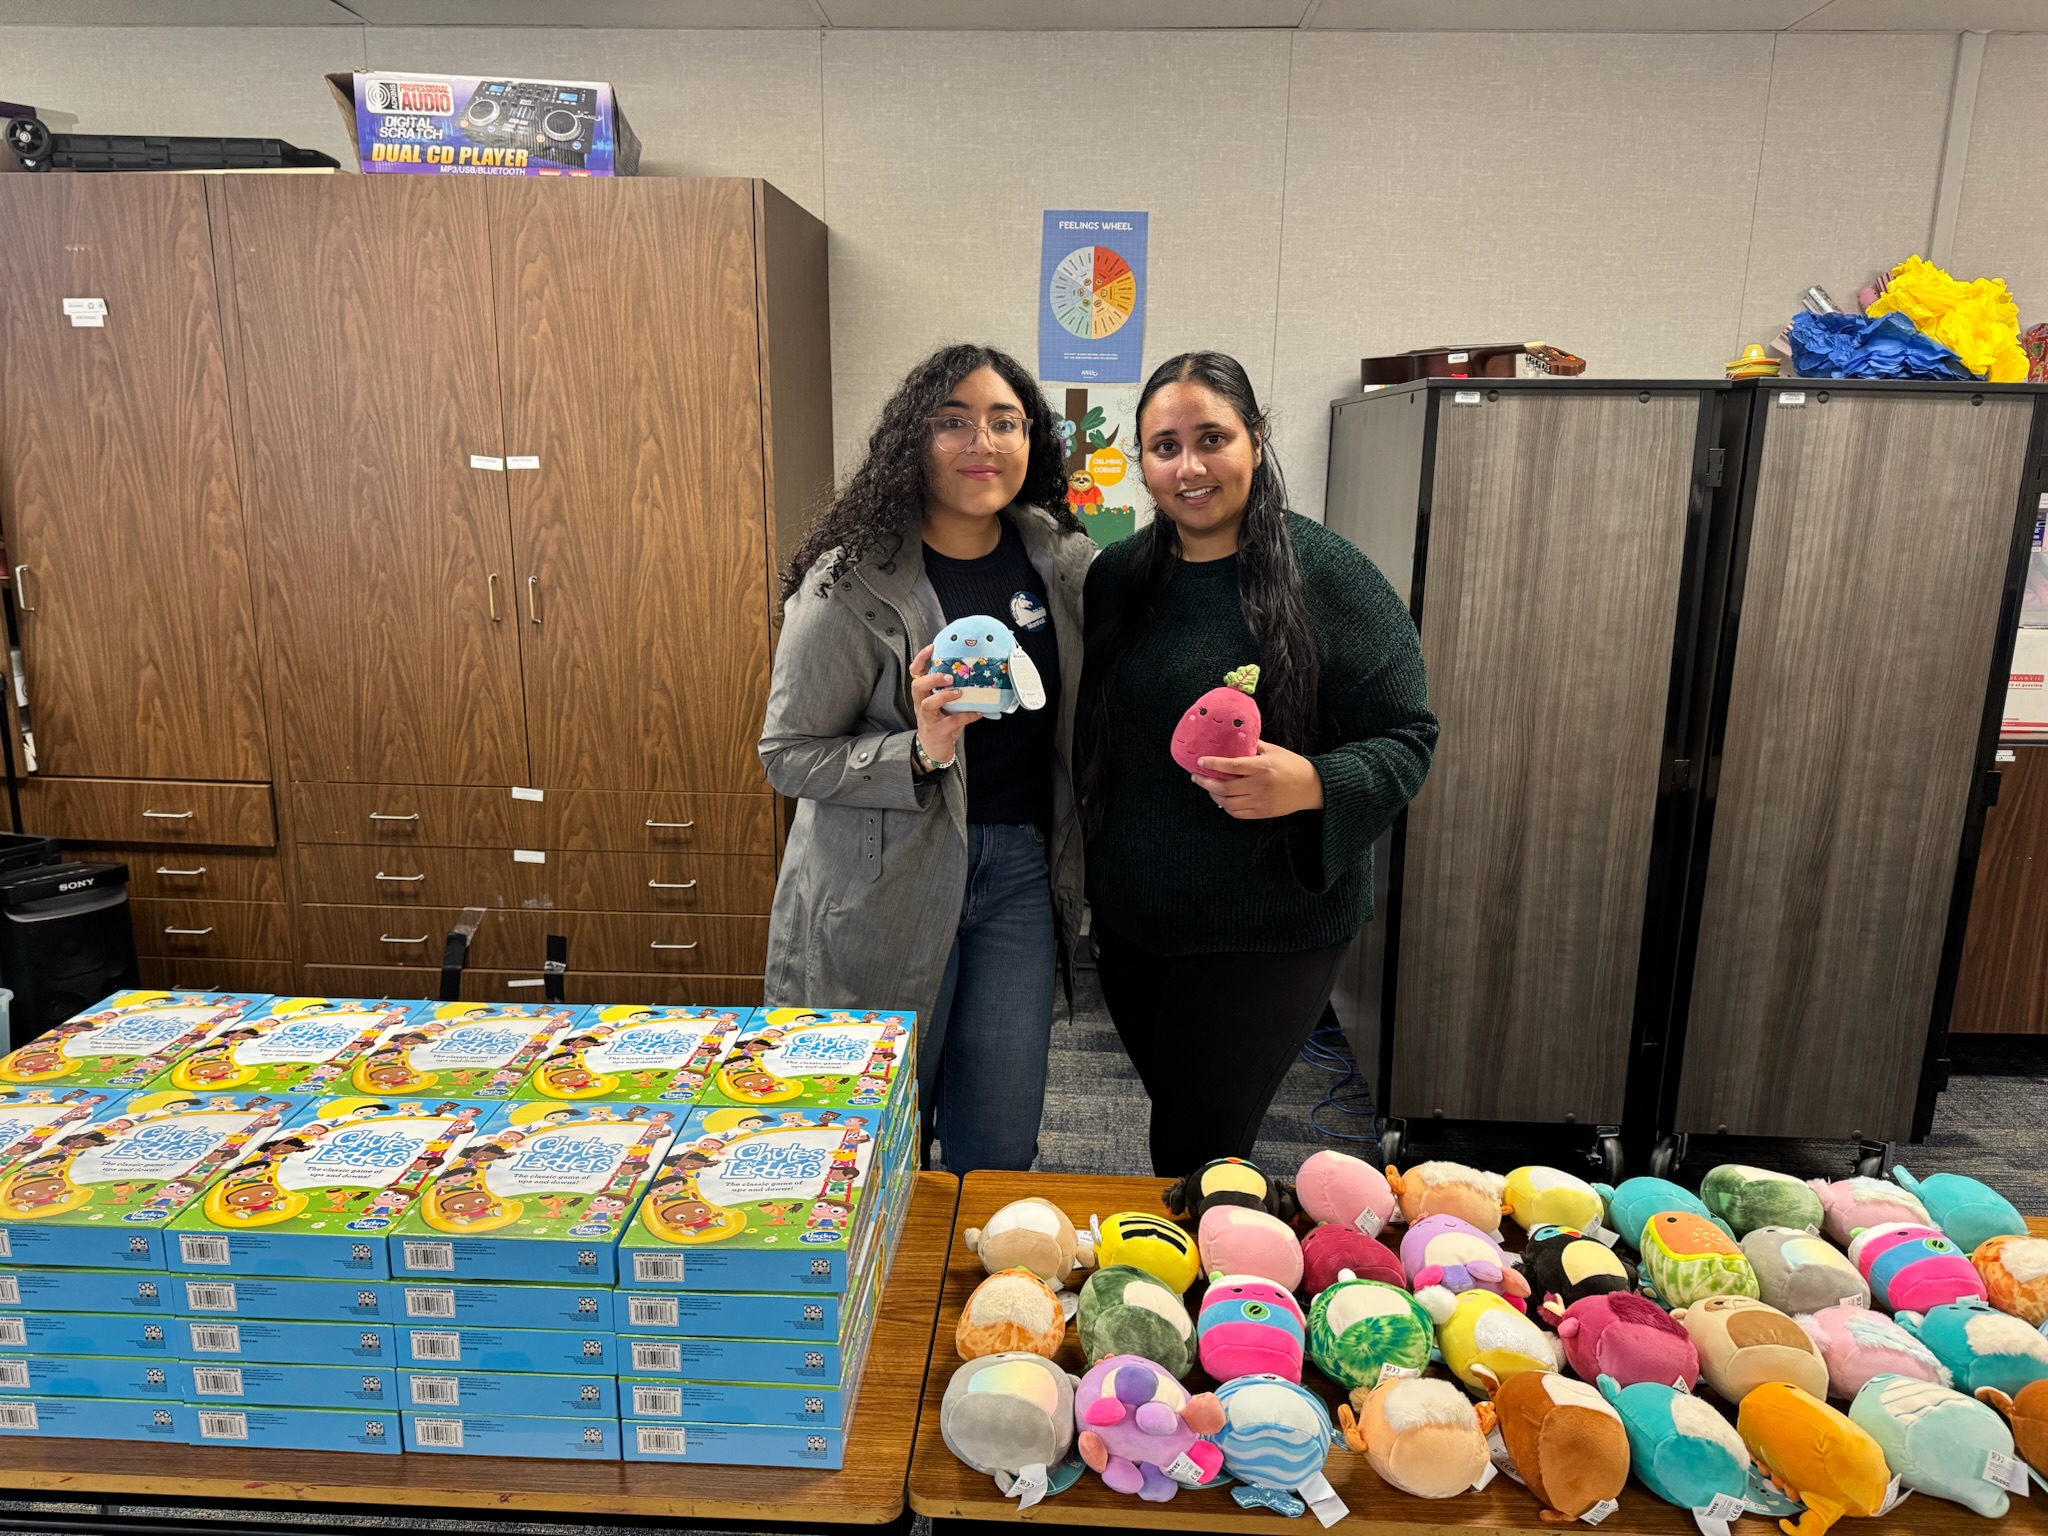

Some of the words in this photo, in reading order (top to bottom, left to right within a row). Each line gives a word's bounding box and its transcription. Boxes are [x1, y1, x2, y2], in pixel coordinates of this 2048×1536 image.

[399, 83, 449, 95] PROFESSIONAL
[401, 92, 451, 113] AUDIO
[385, 115, 434, 131] DIGITAL
[379, 127, 444, 141] SCRATCH
[371, 143, 420, 164] DUAL
[426, 146, 455, 165] CD
[458, 148, 529, 168] PLAYER
[440, 165, 526, 176] MP3/USB/BLUETOOTH
[1059, 221, 1100, 230] FEELINGS
[1102, 222, 1133, 231] WHEEL
[1092, 458, 1123, 466] CALMING
[59, 878, 95, 891] SONY
[116, 1016, 195, 1031] Chutes
[281, 1022, 360, 1037] Chutes
[88, 1026, 181, 1041] Ladders
[256, 1033, 348, 1048] Ladders
[451, 1028, 528, 1044] Chutes
[621, 1029, 698, 1044] Chutes
[793, 1033, 869, 1049] Chutes
[429, 1039, 518, 1054] Ladders
[604, 1041, 690, 1055] Ladders
[781, 1045, 865, 1060] Ladders
[132, 1125, 225, 1145] Chutes
[332, 1130, 424, 1152] Chutes
[99, 1140, 209, 1160] Ladders
[532, 1136, 623, 1157] Chutes
[735, 1143, 826, 1163] Chutes
[304, 1145, 411, 1166] Ladders
[509, 1152, 613, 1172] Ladders
[720, 1159, 821, 1179] Ladders
